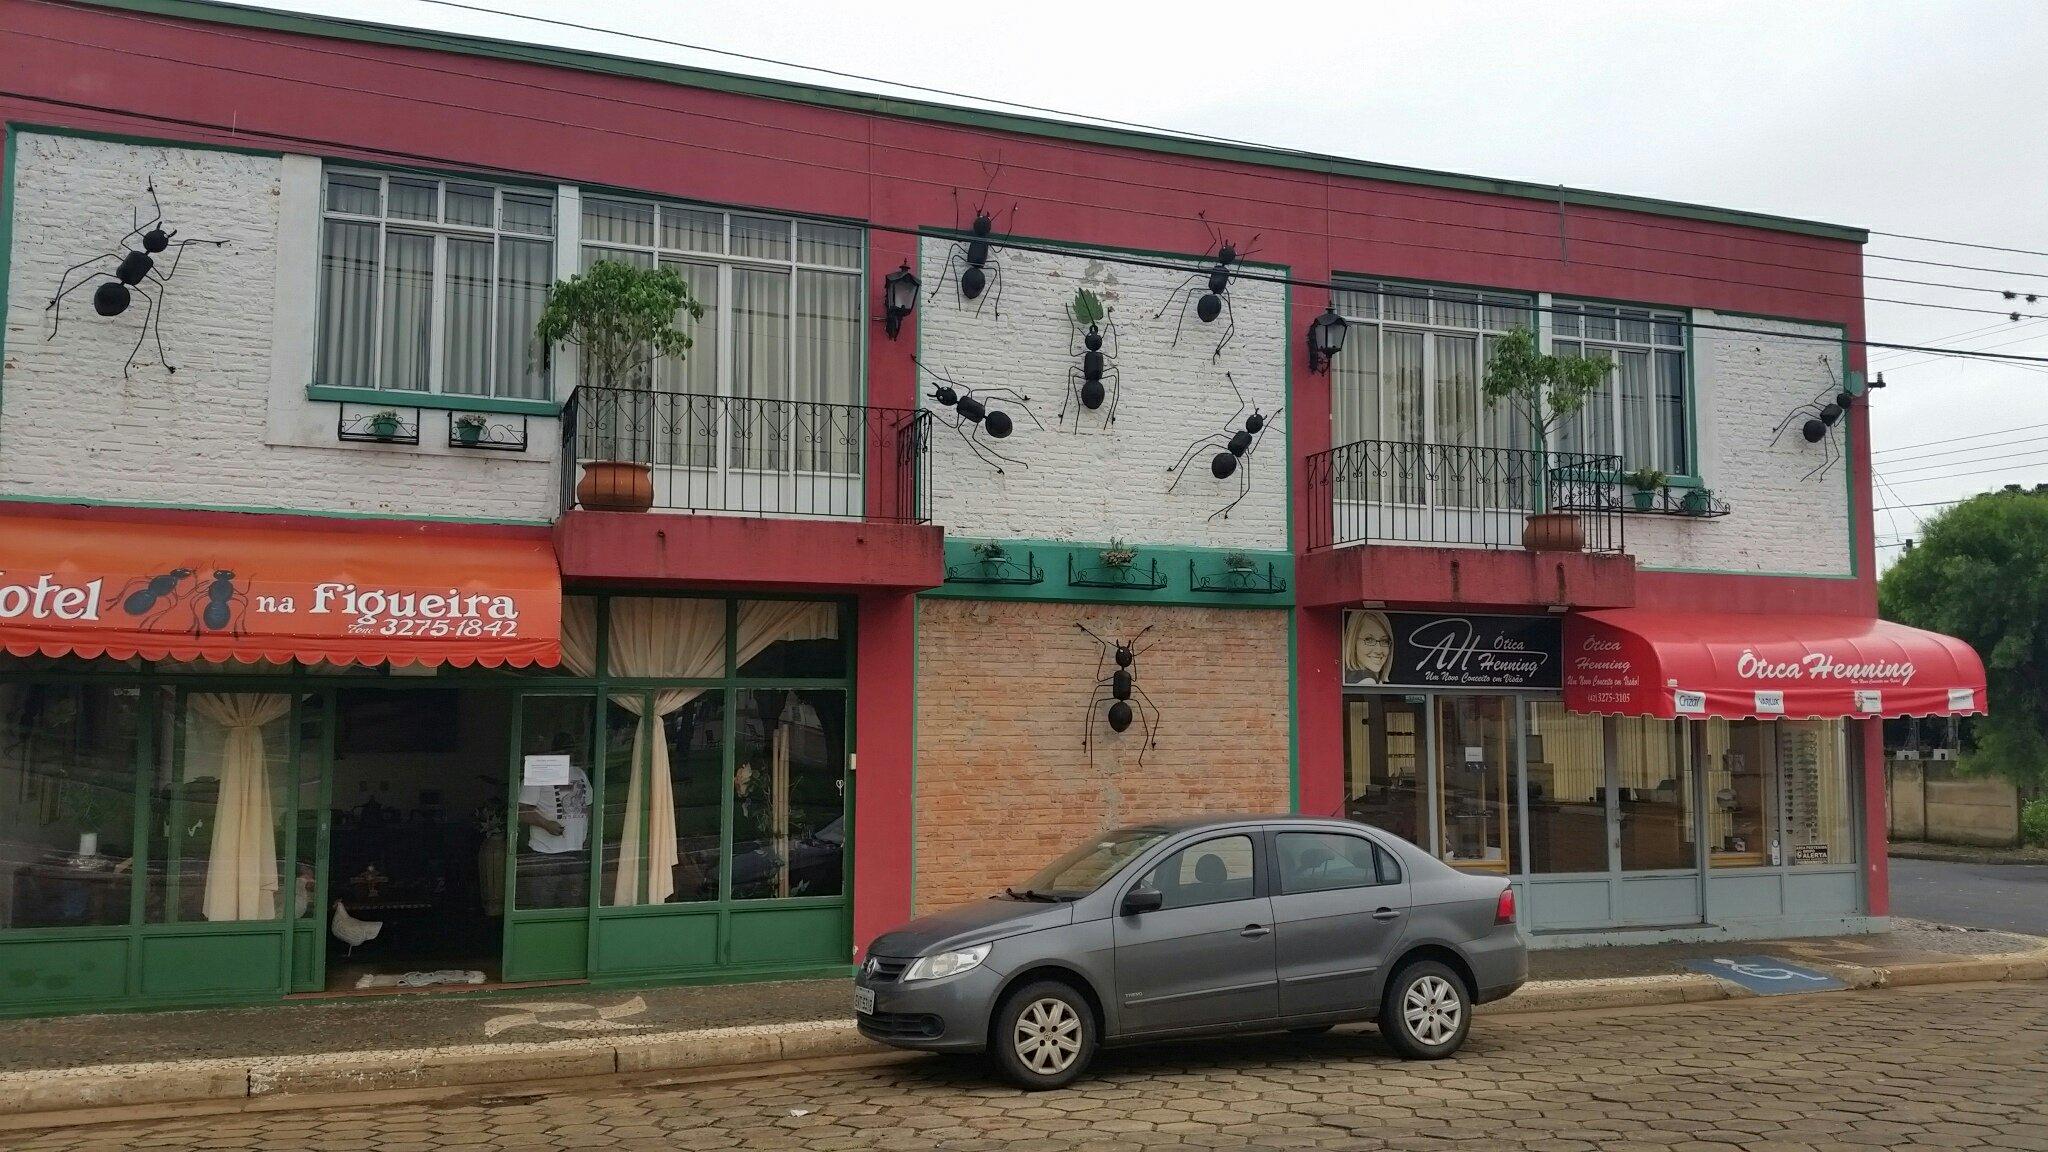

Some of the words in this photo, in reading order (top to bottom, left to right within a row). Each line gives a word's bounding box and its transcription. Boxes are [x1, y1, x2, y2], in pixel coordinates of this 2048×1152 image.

[0, 571, 104, 621] otel
[256, 595, 295, 613] na
[309, 583, 519, 625] Figueira
[380, 618, 519, 637] 3275-1842
[1478, 653, 1538, 677] Henning
[1575, 657, 1631, 673] Henning
[1803, 653, 1916, 686] Henning
[1425, 671, 1439, 681] Um
[1441, 671, 1459, 681] Novo
